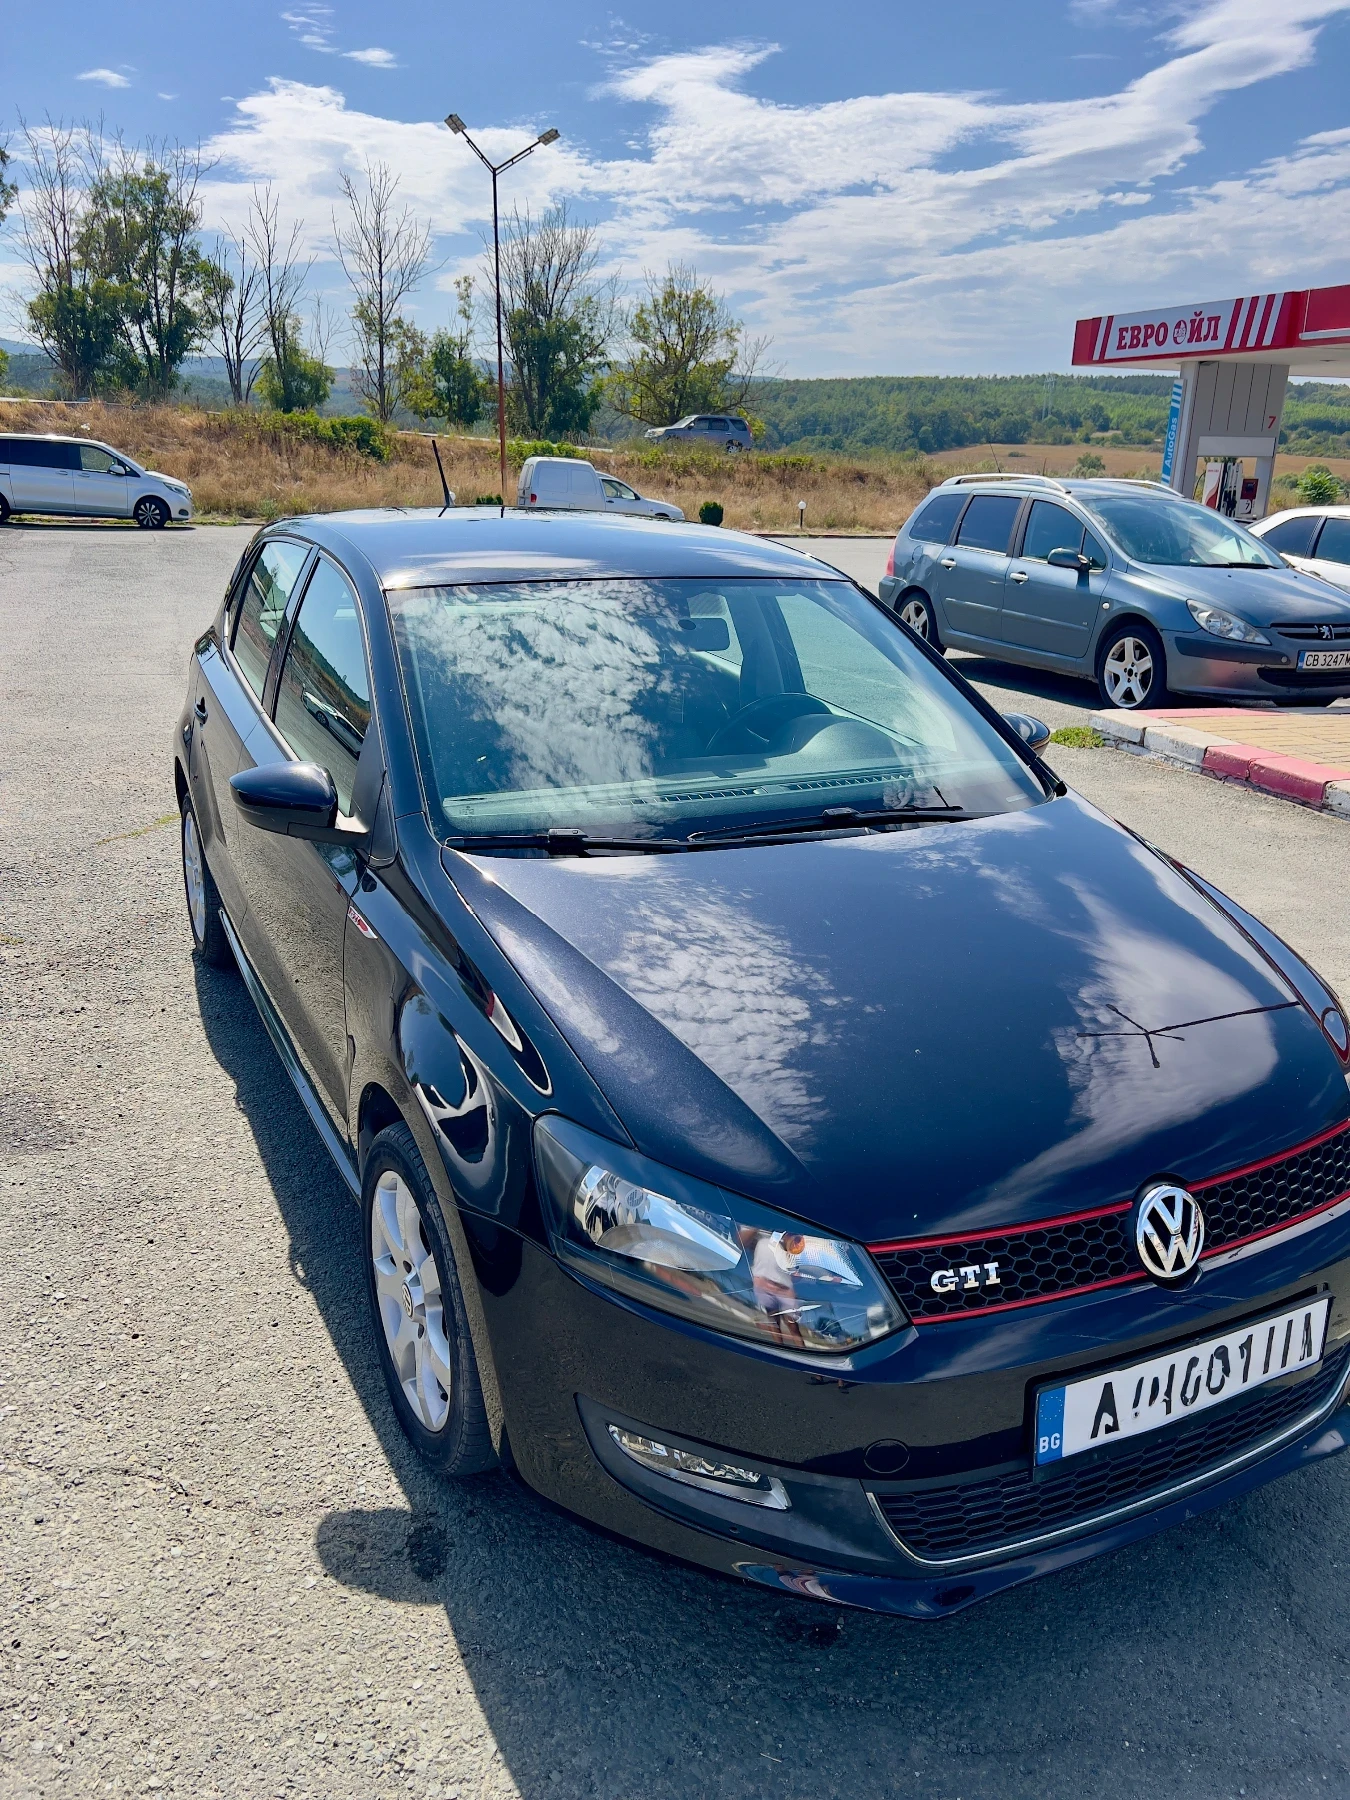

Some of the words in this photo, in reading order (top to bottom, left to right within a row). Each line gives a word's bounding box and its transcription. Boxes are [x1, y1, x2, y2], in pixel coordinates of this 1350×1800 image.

[1116, 321, 1168, 350] ЕВРО
[1268, 415, 1277, 429] 7
[1165, 417, 1177, 468] AutoGas
[930, 1262, 1001, 1293] GTI
[1039, 1432, 1061, 1454] BG
